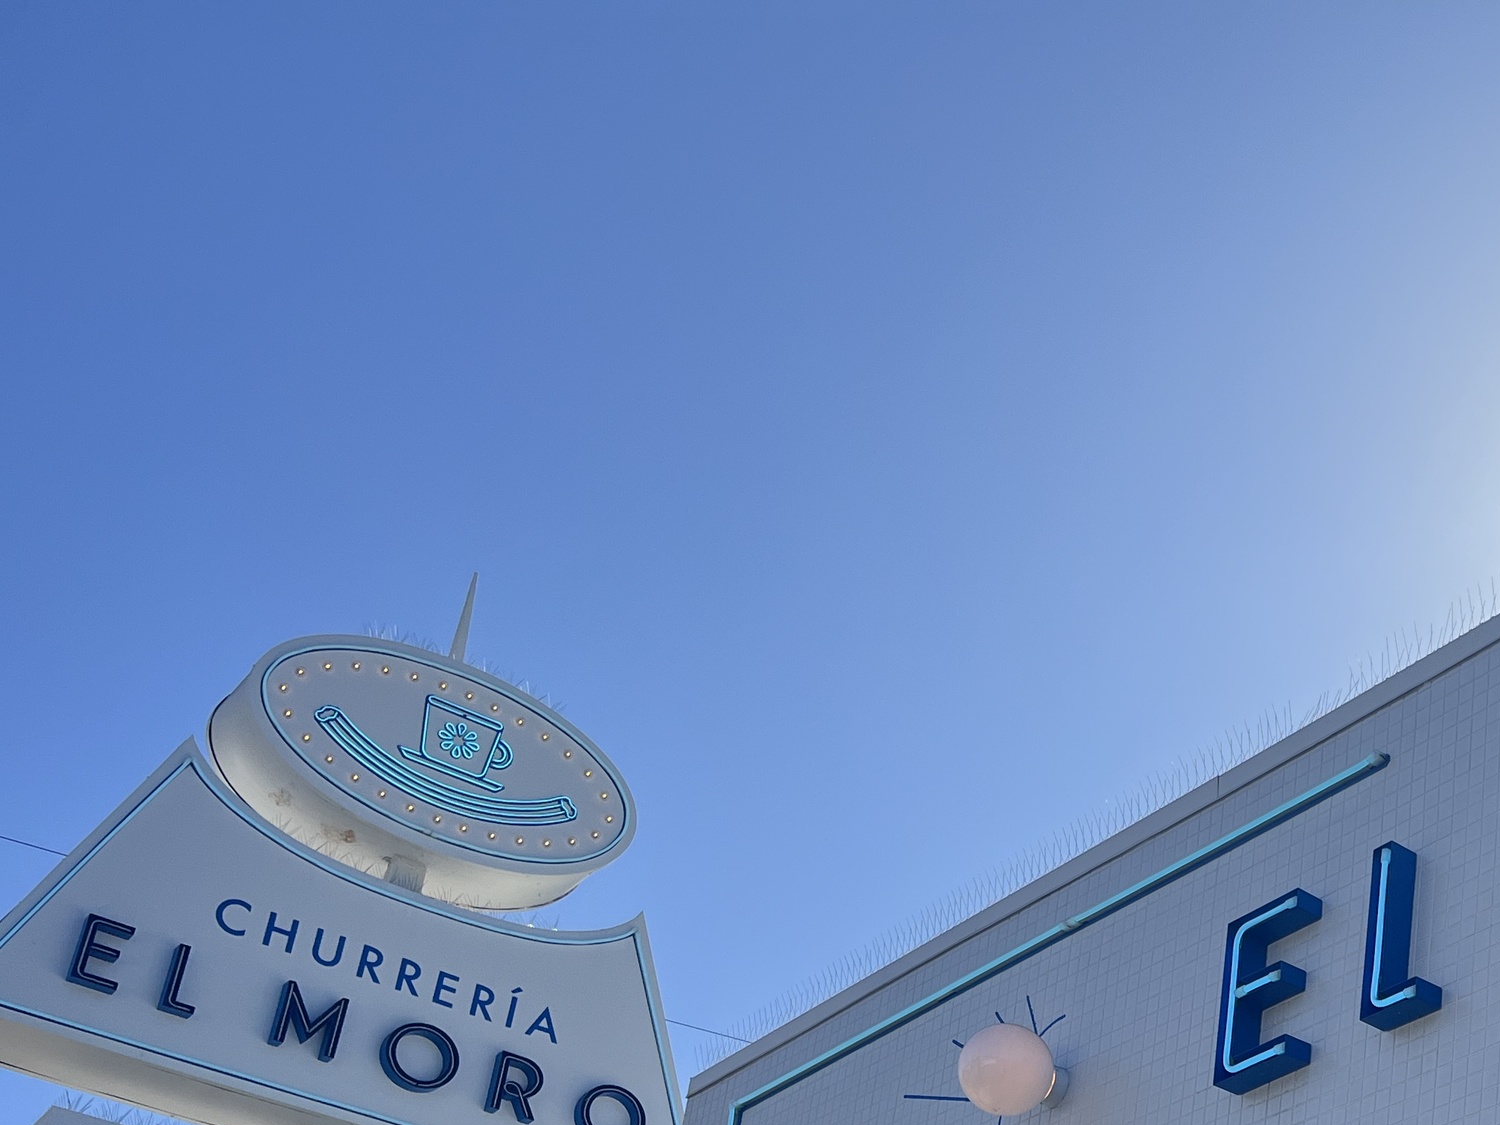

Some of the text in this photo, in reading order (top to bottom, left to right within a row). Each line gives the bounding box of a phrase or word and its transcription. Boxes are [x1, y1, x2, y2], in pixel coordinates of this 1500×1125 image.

[66, 913, 196, 1020] EL
[215, 898, 557, 1044] CHURRERÍA
[1213, 840, 1443, 1095] EL
